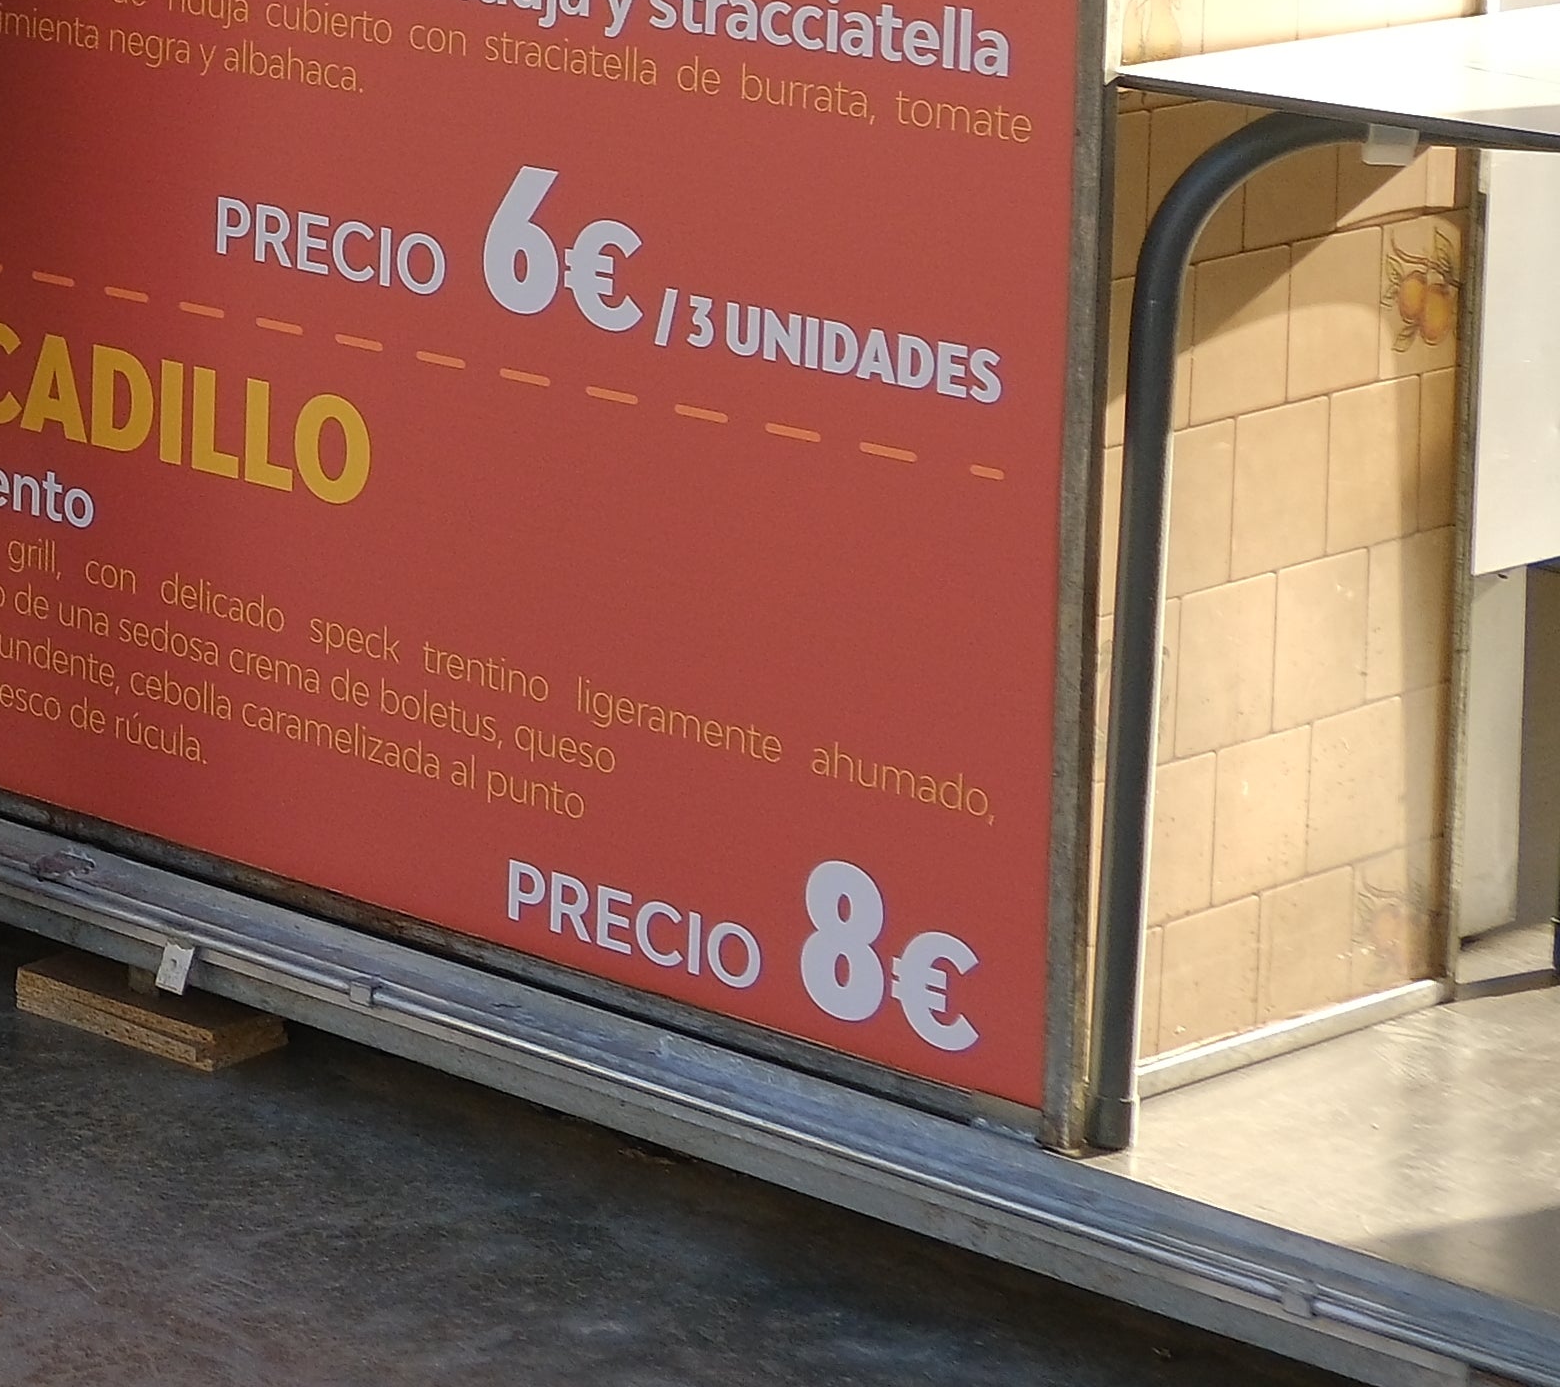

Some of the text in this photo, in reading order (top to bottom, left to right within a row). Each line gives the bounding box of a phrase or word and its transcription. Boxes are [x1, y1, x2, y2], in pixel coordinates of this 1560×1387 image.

[109, 27, 190, 68] negra
[200, 41, 215, 75] y
[224, 45, 365, 94] albahaca.
[410, 24, 466, 56] con
[485, 31, 657, 85] straciatella
[678, 55, 721, 95] de
[741, 62, 876, 125] burrata,
[896, 90, 1032, 143] tomate
[215, 196, 446, 295] PRECIO
[482, 165, 644, 332] 6€
[725, 302, 1003, 404] UNIDADES
[8, 537, 61, 580] grill,
[85, 558, 136, 595] con
[160, 572, 285, 633] delicado
[309, 615, 400, 664] speck
[423, 640, 549, 703] trentino
[576, 675, 782, 763] ligeramente
[811, 741, 995, 827] ahumado,
[14, 583, 49, 620] de
[59, 606, 109, 637] una
[119, 618, 220, 668] sedosa
[229, 644, 320, 695] crema
[330, 668, 370, 707] de
[380, 678, 503, 749] boletus,
[514, 724, 616, 776] queso
[69, 698, 106, 735] de
[114, 711, 209, 766] rúcula.
[129, 670, 232, 722] cebolla
[242, 700, 441, 781] caramelizada
[450, 754, 476, 791] al
[487, 767, 585, 819] punto
[506, 857, 980, 1051] PRECIO 8€
